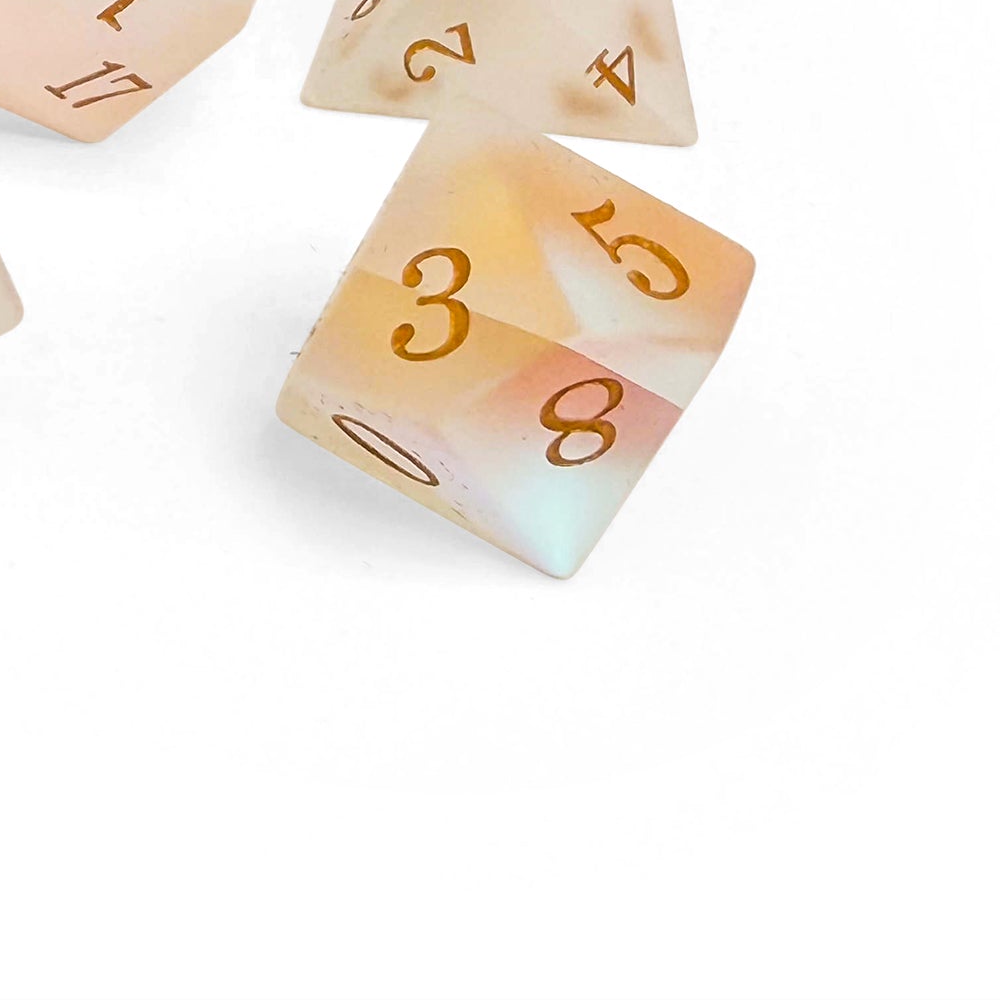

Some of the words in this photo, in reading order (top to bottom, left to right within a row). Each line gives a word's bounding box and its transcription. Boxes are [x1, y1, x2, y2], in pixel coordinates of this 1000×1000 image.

[44, 60, 153, 108] 17
[404, 23, 476, 82] 2
[585, 46, 636, 106] 4
[571, 199, 690, 301] 5
[391, 248, 471, 361] 3
[331, 414, 440, 487] 0
[540, 377, 624, 467] 8
